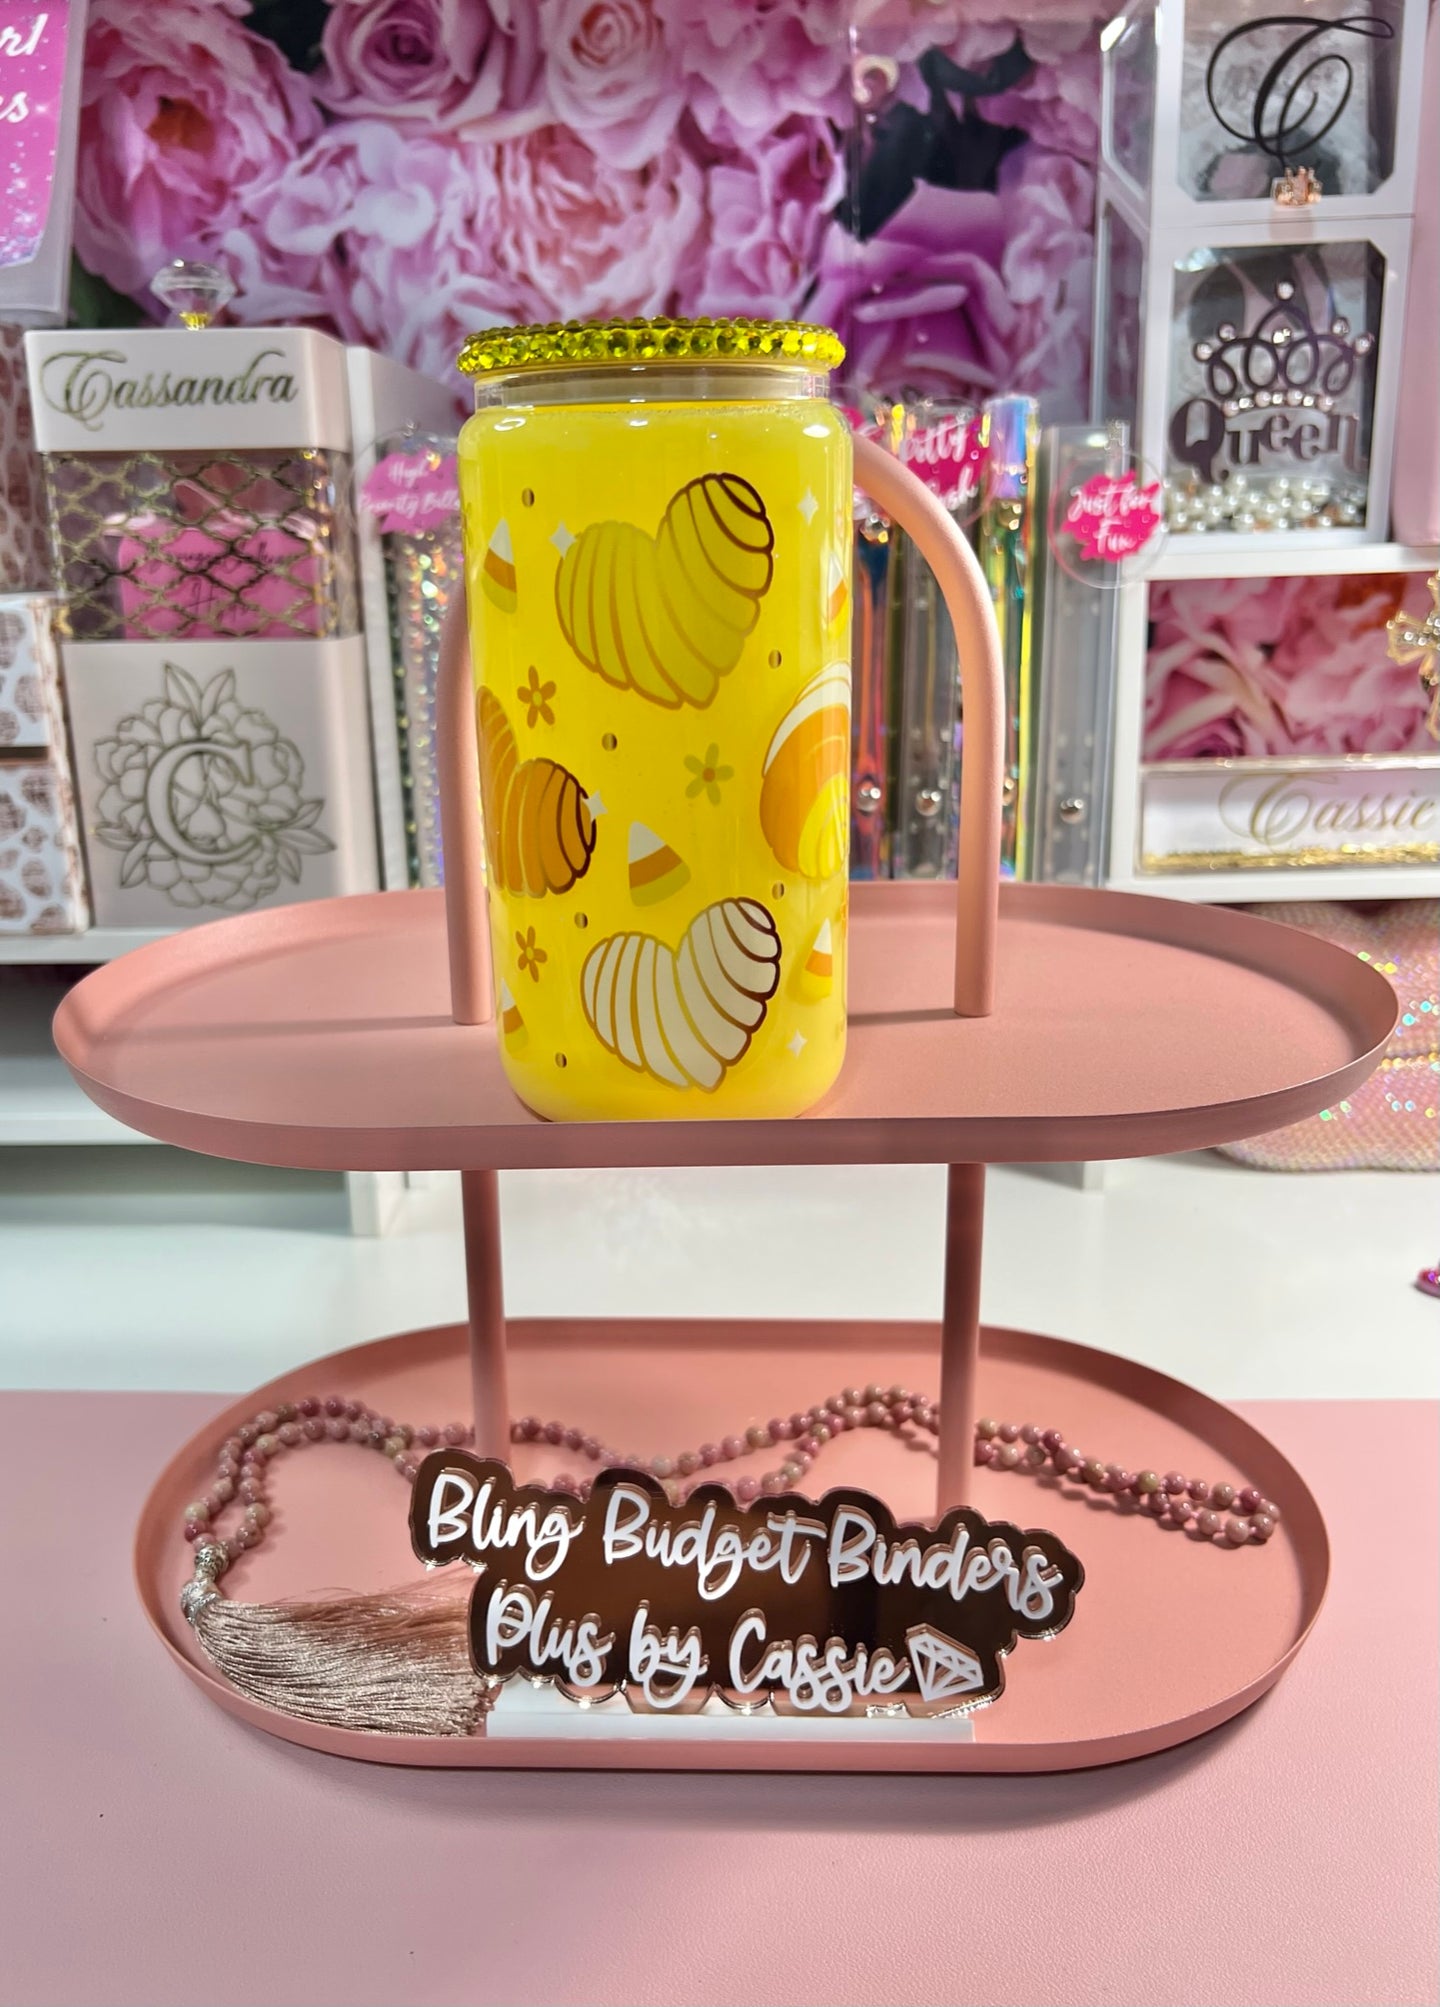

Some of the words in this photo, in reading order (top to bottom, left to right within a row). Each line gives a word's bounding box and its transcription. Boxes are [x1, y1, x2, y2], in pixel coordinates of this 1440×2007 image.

[39, 350, 298, 432] Cassandra
[1168, 397, 1368, 482] Queen
[1068, 480, 1114, 522] Just
[1094, 519, 1139, 554] Fun
[144, 738, 261, 867] C
[1218, 773, 1436, 855] Cassie
[428, 1472, 585, 1580] Bling
[603, 1488, 827, 1600] Budget
[829, 1510, 1063, 1620] Binders
[487, 1584, 615, 1687] Plus
[630, 1604, 708, 1708] by
[729, 1615, 911, 1712] Cassie
